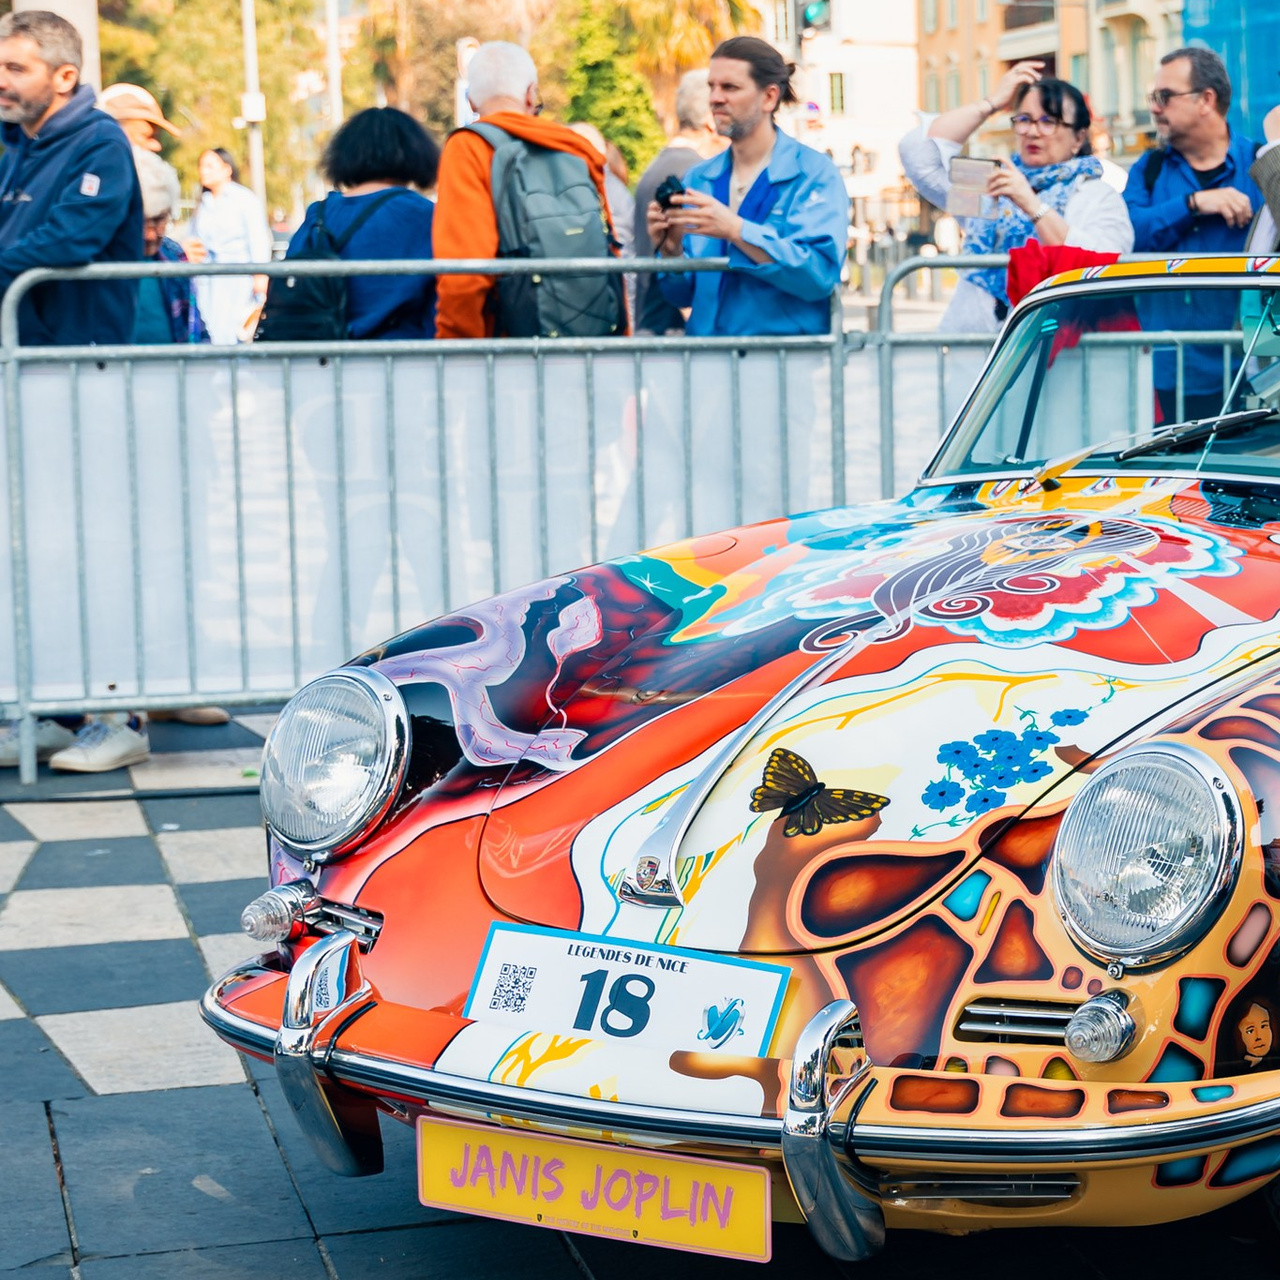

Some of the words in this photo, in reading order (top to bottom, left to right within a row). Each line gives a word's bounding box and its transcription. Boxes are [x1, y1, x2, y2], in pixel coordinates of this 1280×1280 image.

[567, 943, 633, 964] LEGENDES
[634, 953, 655, 968] DE
[656, 956, 690, 974] NICE
[572, 968, 656, 1039] 18
[449, 1142, 565, 1203] JANIS
[580, 1163, 735, 1230] JOPLIN
